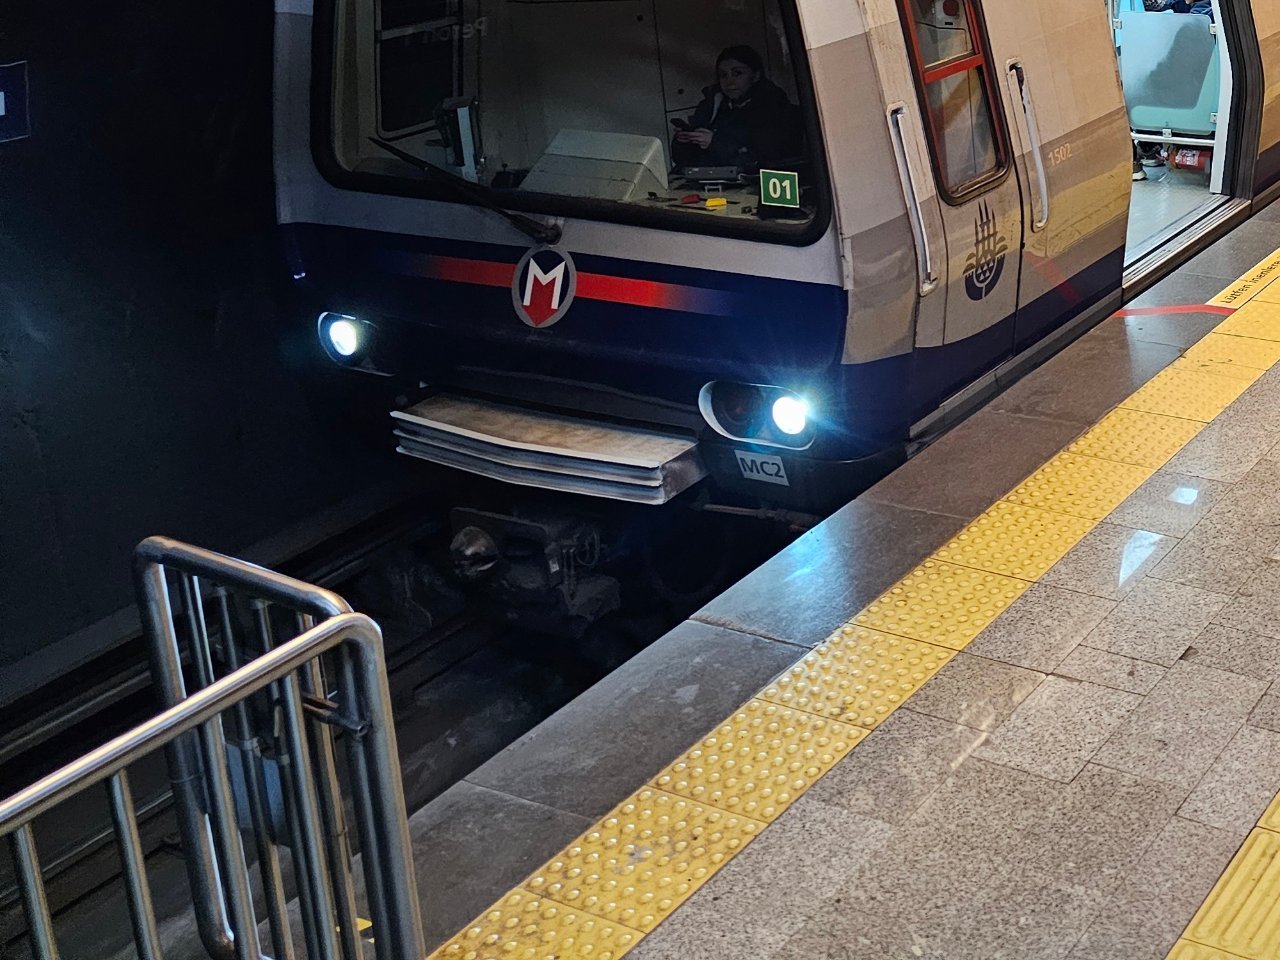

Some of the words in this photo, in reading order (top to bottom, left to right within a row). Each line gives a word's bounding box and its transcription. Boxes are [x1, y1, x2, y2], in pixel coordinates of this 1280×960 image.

[769, 178, 791, 199] 01
[523, 257, 566, 310] M
[1219, 282, 1253, 304] Lütfen
[739, 457, 784, 478] MC2
